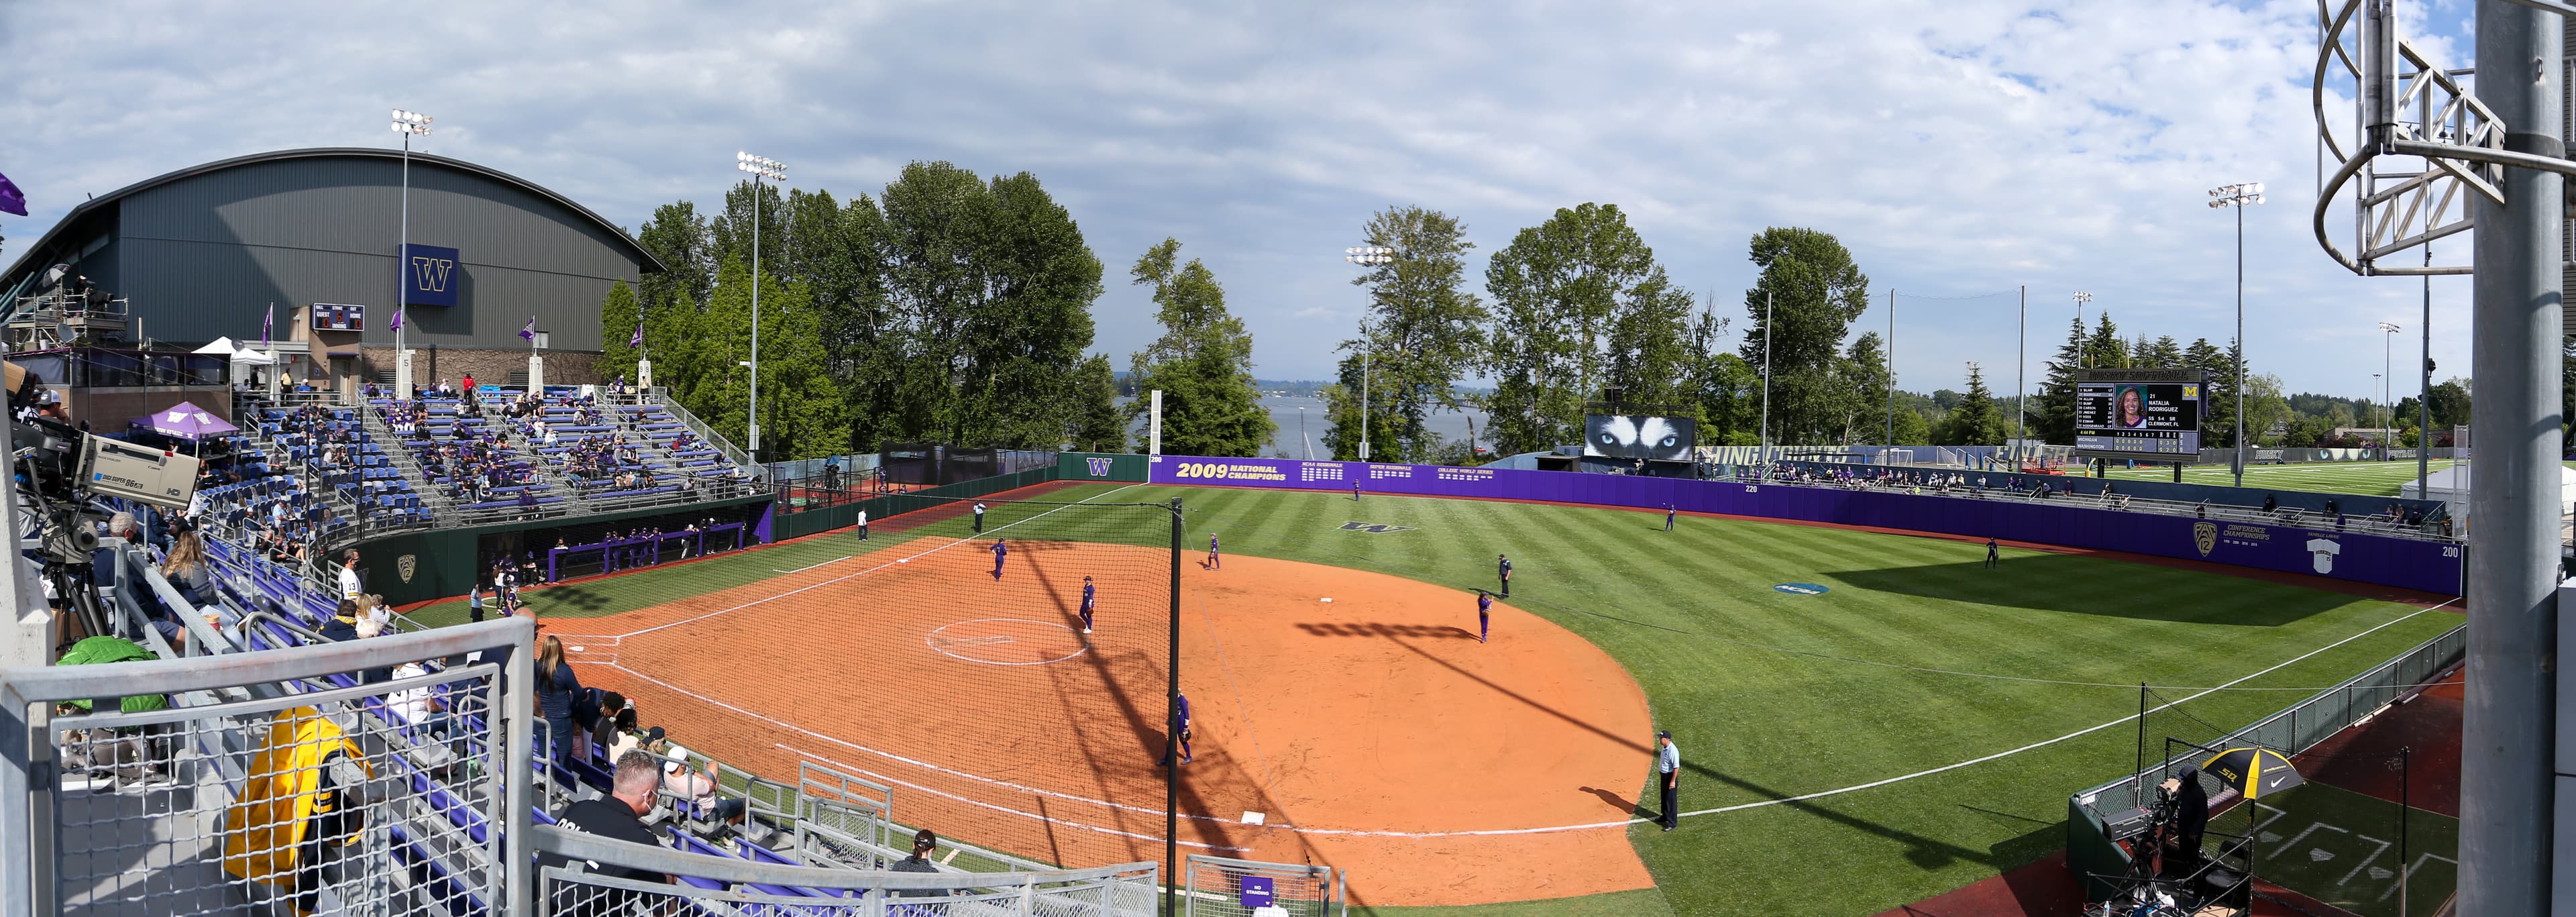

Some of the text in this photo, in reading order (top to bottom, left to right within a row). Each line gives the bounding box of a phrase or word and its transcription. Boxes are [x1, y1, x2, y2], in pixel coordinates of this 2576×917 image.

[413, 257, 451, 291] W
[2088, 370, 2188, 380] HUSKY SOFTBALL
[2184, 386, 2198, 397] M
[168, 411, 188, 423] W
[2255, 450, 2284, 460] HUSKY
[1087, 457, 1112, 476] W
[1176, 463, 1277, 478] 2009 NATIONAL
[1228, 472, 1286, 481] CHAMPIONS
[166, 488, 180, 496] HD
[2227, 525, 2265, 534] CONFERENCE
[2223, 530, 2270, 541] CHAMPIONSHIPS
[2200, 541, 2210, 551] 12
[2443, 546, 2458, 558] 200
[403, 570, 410, 578] 12
[1775, 585, 1821, 594] NCAA
[2217, 767, 2238, 783] SQ
